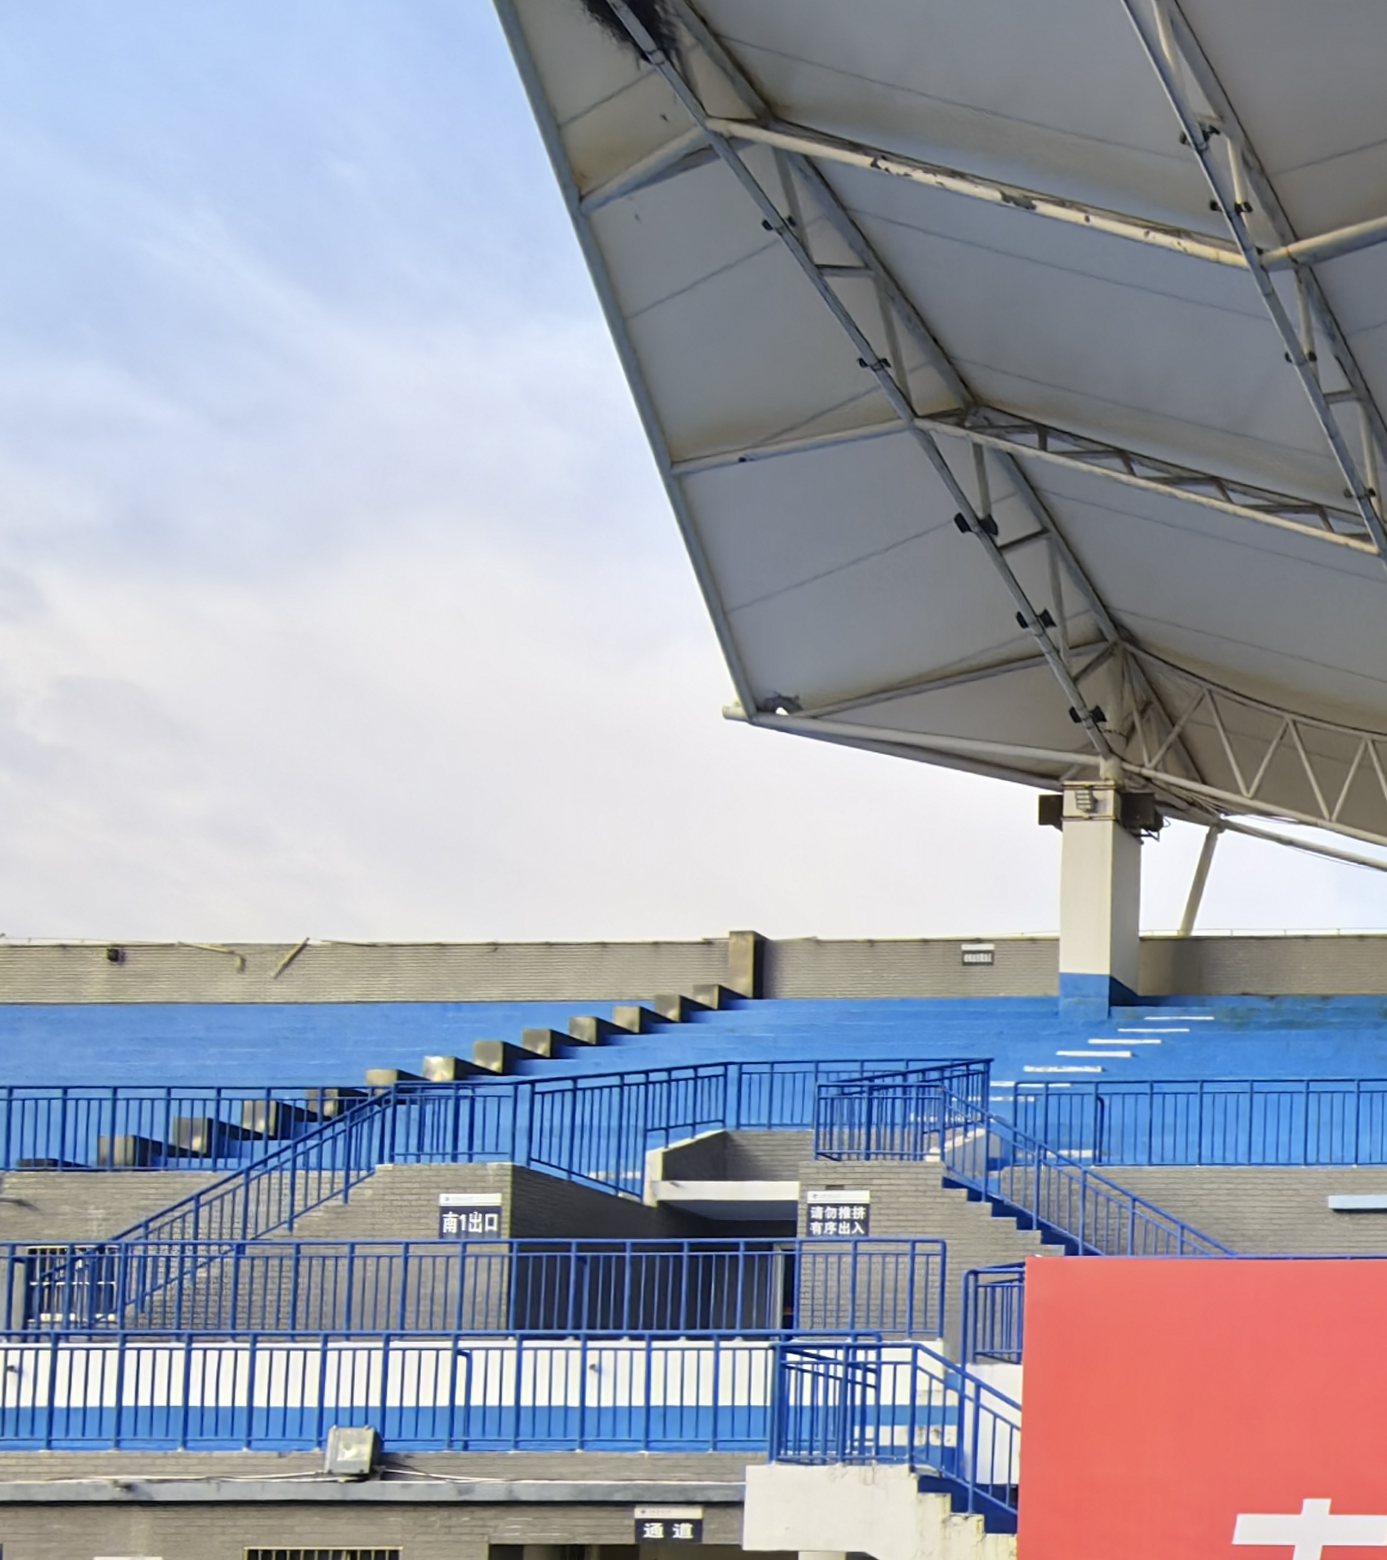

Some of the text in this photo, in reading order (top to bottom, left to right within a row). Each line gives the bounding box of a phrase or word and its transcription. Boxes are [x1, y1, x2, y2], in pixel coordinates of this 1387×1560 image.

[811, 1206, 866, 1220] 请勿推挤
[442, 1211, 498, 1233] 南1出口
[810, 1221, 865, 1235] 有序出入
